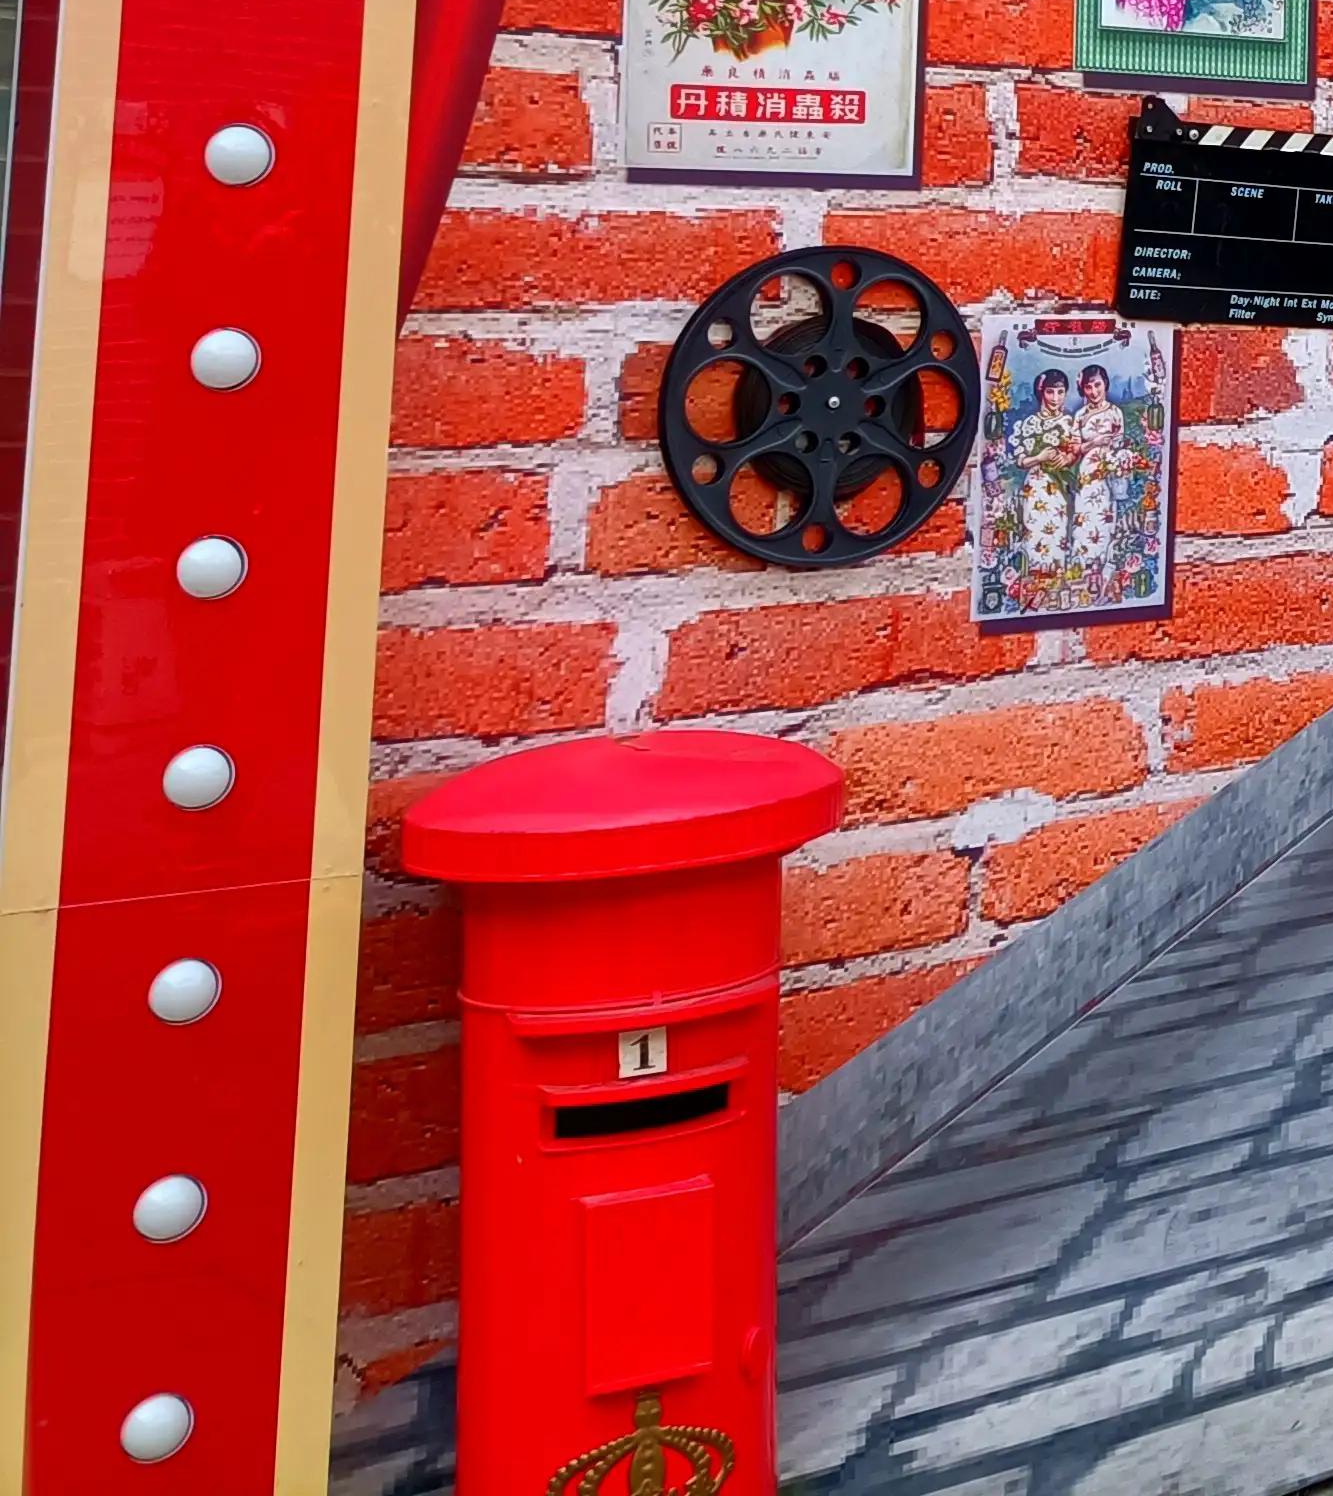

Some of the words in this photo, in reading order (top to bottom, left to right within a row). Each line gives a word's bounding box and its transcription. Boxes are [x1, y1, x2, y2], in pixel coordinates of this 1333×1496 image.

[1143, 162, 1174, 174] PROD.
[1155, 180, 1182, 191] ROLL
[1230, 187, 1264, 198] SCENE
[1134, 247, 1191, 260] DIRECTOR:
[1132, 267, 1181, 280] CAMERA:
[1129, 289, 1161, 300] DATE:
[1283, 297, 1298, 308] Int
[1301, 298, 1317, 309] Ext
[1229, 309, 1256, 319] Filter
[629, 1033, 656, 1071] 1
